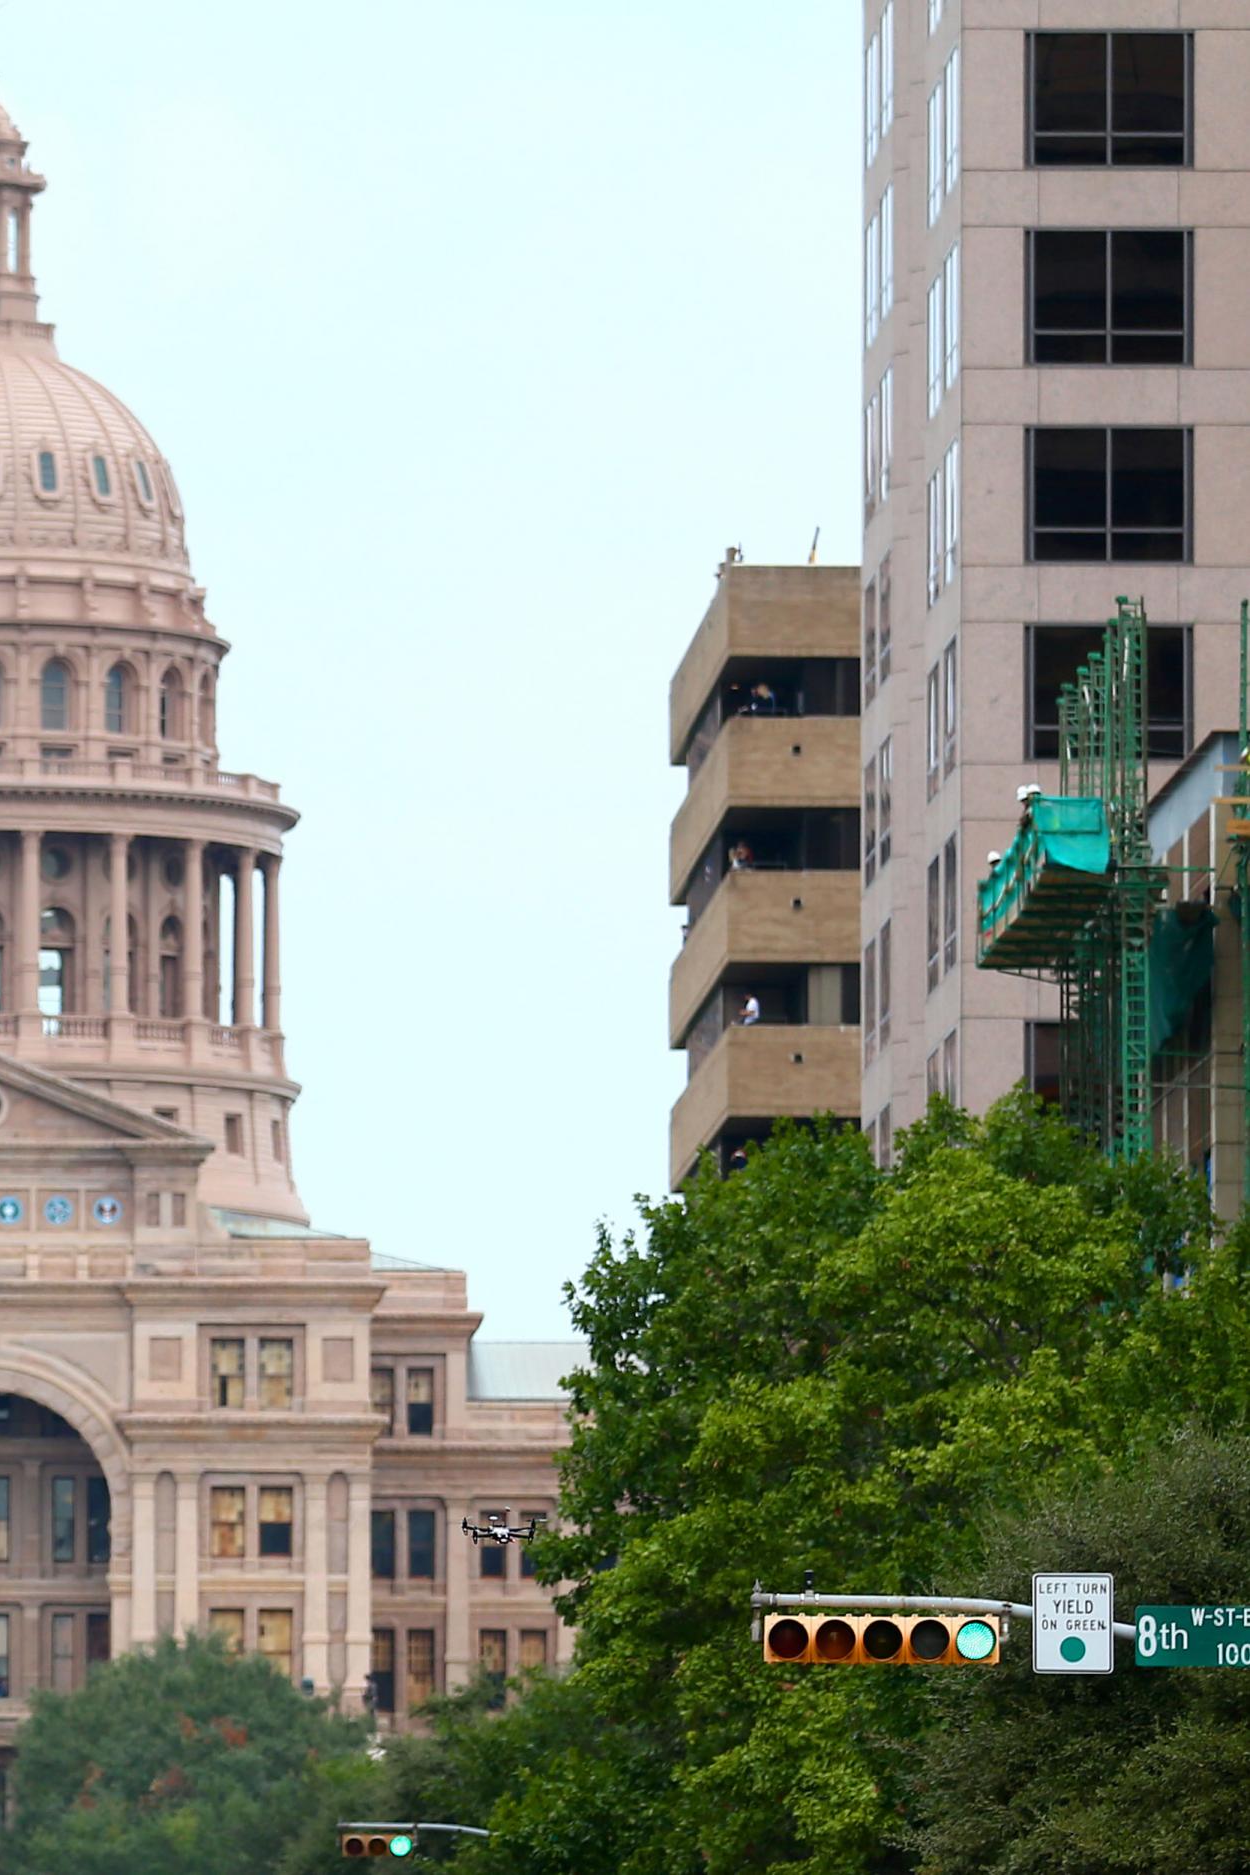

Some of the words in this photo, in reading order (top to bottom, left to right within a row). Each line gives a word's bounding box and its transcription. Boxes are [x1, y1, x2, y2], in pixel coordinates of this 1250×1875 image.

[1038, 1583, 1067, 1594] LEFT
[1076, 1583, 1107, 1594] TURN
[1053, 1600, 1094, 1614] YIELD
[1041, 1619, 1057, 1630] ON
[1066, 1619, 1106, 1631] GREEN
[1138, 1614, 1188, 1657] 8th
